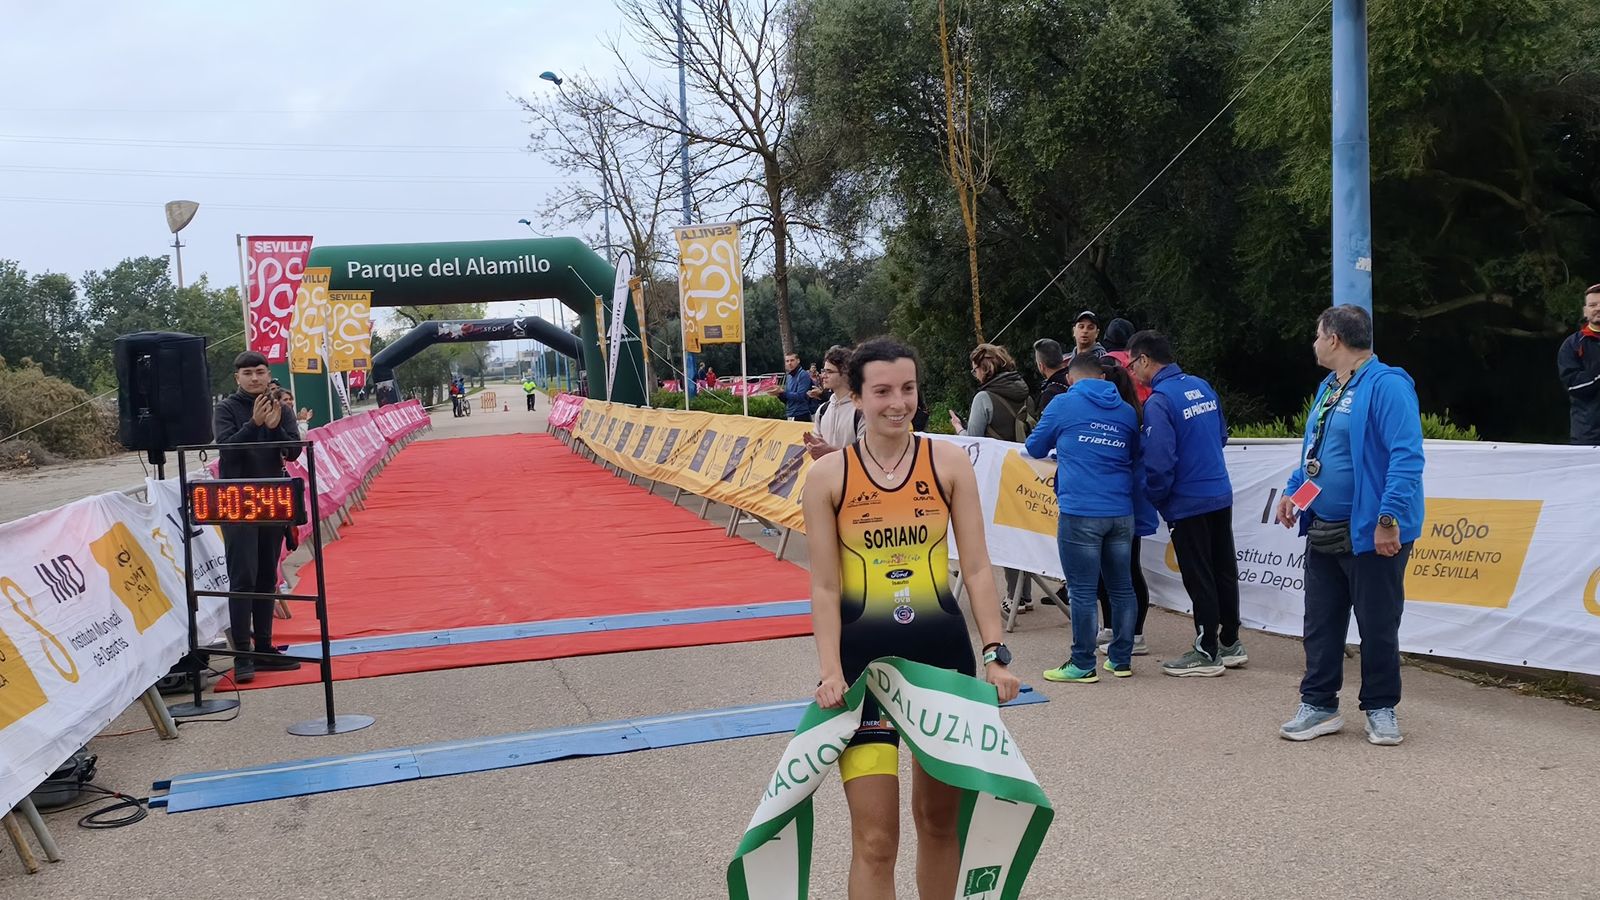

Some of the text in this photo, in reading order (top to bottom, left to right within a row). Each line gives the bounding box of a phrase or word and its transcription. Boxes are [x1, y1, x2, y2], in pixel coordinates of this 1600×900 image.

[254, 241, 308, 253] SEVILLA
[347, 254, 551, 283] Parque del Alamillo
[329, 293, 368, 301] SEVILLA
[1089, 422, 1120, 433] OFICIAL
[863, 524, 928, 550] SORIANO
[890, 570, 909, 579] Ford
[1412, 564, 1430, 577] DE
[1238, 568, 1306, 591] de Depo
